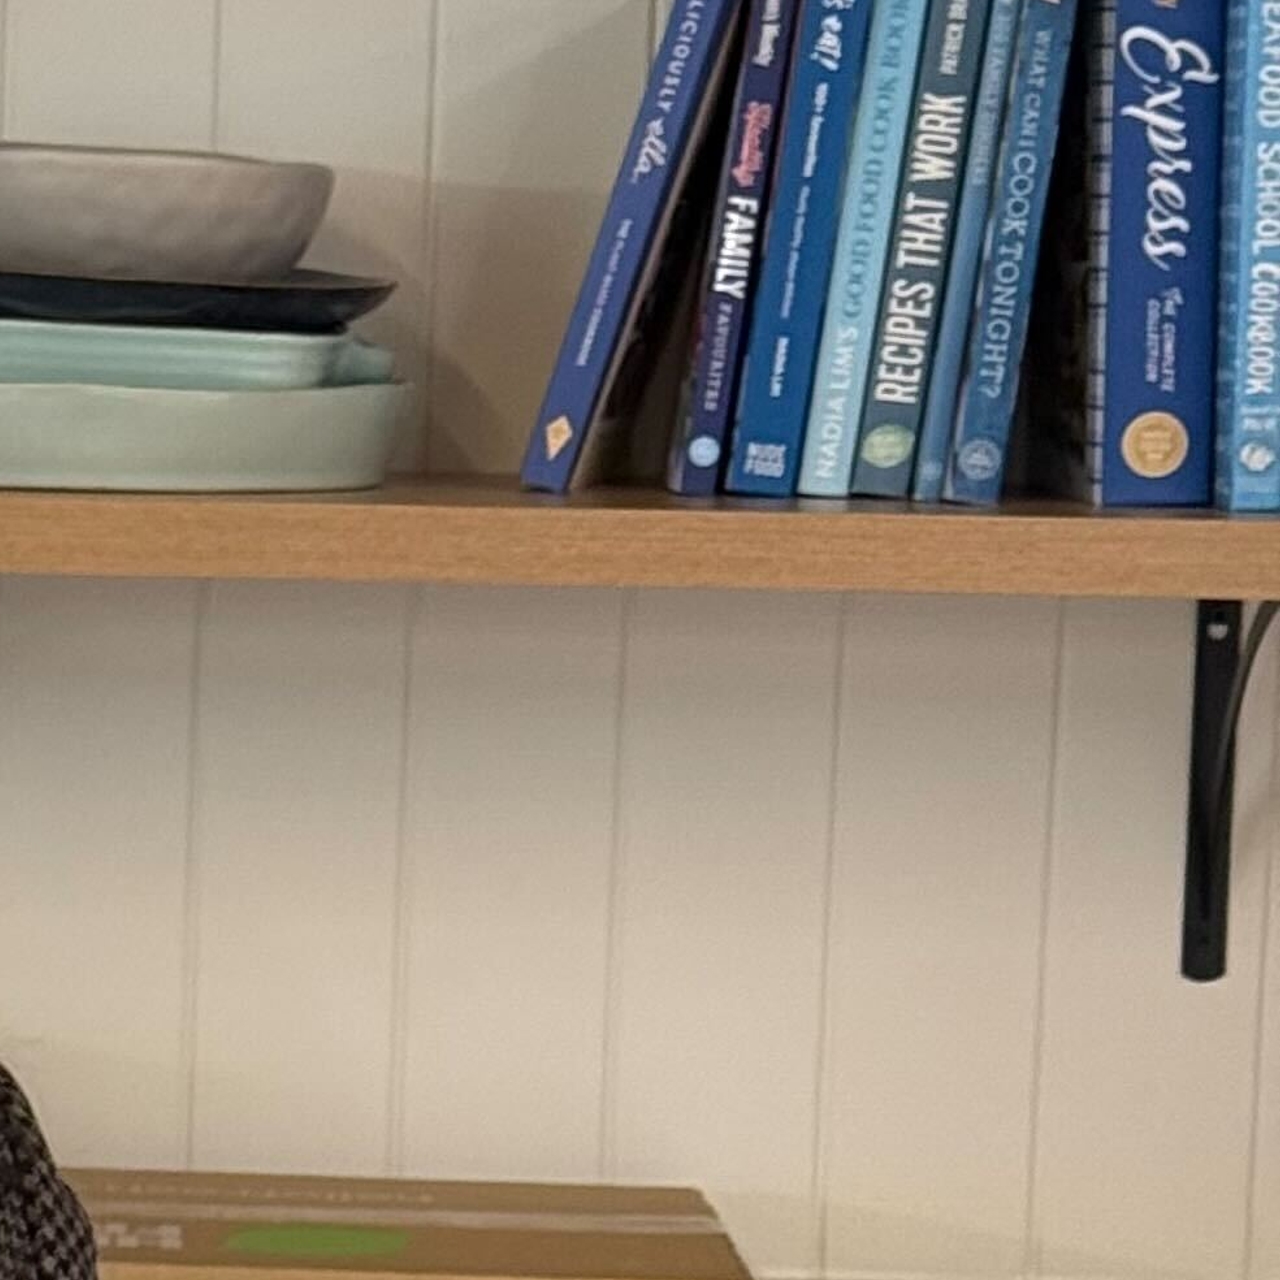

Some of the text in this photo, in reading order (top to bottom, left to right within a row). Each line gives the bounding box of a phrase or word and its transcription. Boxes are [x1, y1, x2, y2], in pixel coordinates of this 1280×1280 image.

[809, 13, 843, 71] eat!
[1026, 29, 1052, 88] WHAT
[867, 75, 899, 155] COOK
[908, 92, 966, 182] WORK
[1019, 91, 1042, 137] CAN
[1118, 24, 1217, 269] Express
[853, 157, 884, 233] FOOD
[894, 191, 948, 269] THAT
[1000, 150, 1037, 236] COOK
[1250, 140, 1280, 254] SCHOOL
[712, 194, 759, 299] FAMILY
[841, 237, 871, 319] GOOD
[702, 301, 733, 411] FAVOURITES
[828, 325, 859, 390] LIM'S
[873, 278, 935, 403] RECIPES
[978, 241, 1024, 398] TONIGHT?
[1158, 321, 1176, 391] COMPLETE
[1244, 261, 1279, 395] COOKBOOK
[814, 393, 846, 478] NADIA
